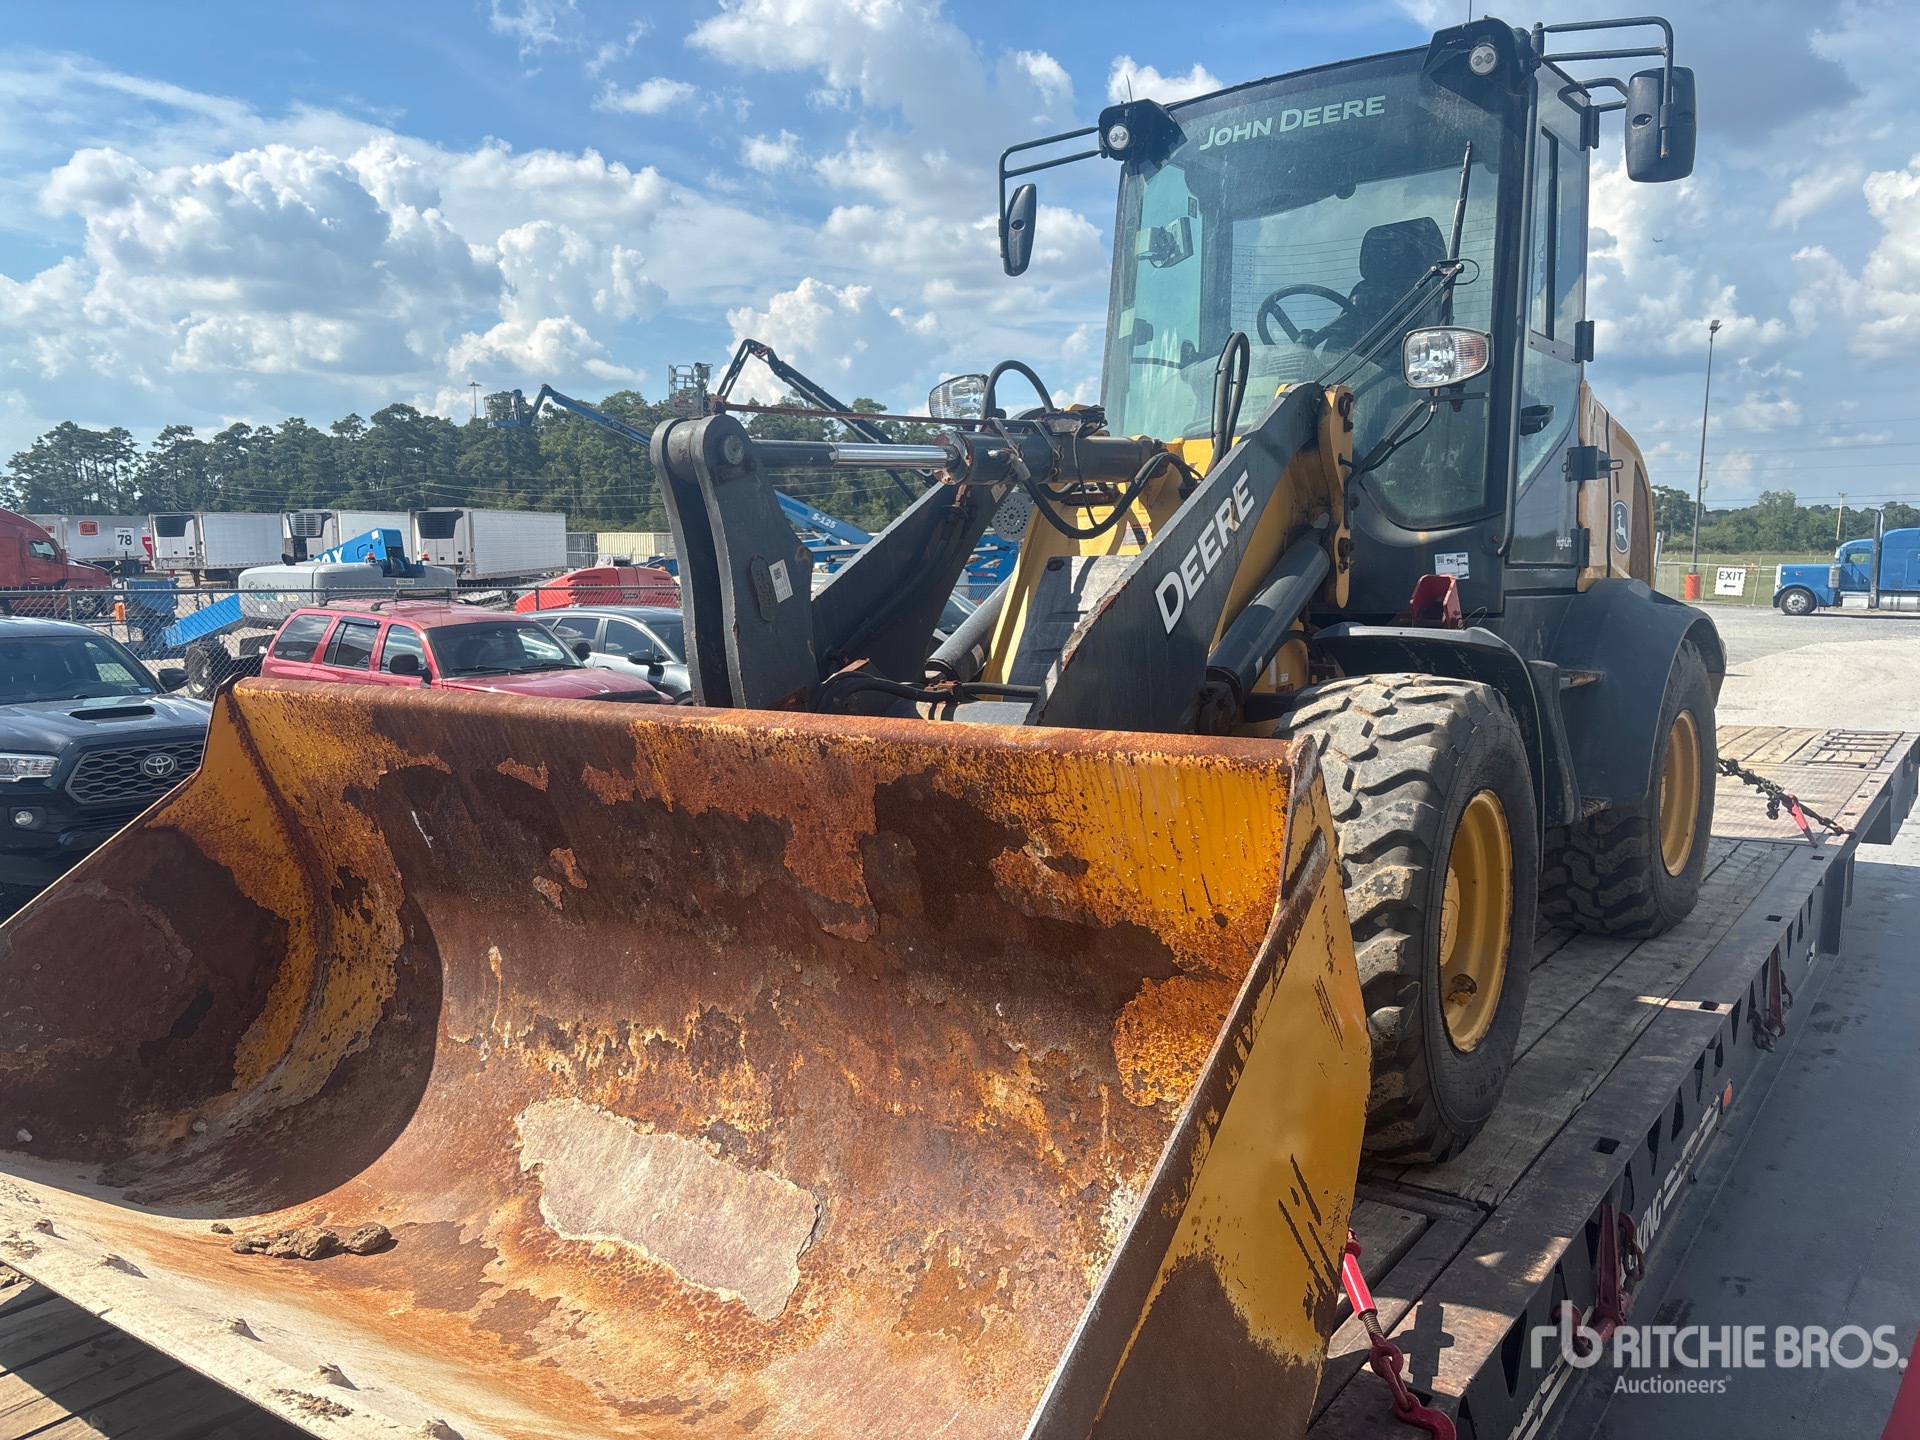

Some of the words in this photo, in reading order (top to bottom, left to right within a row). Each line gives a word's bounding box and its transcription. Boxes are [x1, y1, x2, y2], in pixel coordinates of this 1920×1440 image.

[1200, 117, 1272, 151] JOHN
[1280, 95, 1386, 132] DEERE
[812, 512, 837, 529] S-125
[117, 534, 132, 546] 78
[1155, 469, 1255, 635] DEERE
[1718, 571, 1744, 581] EXIT
